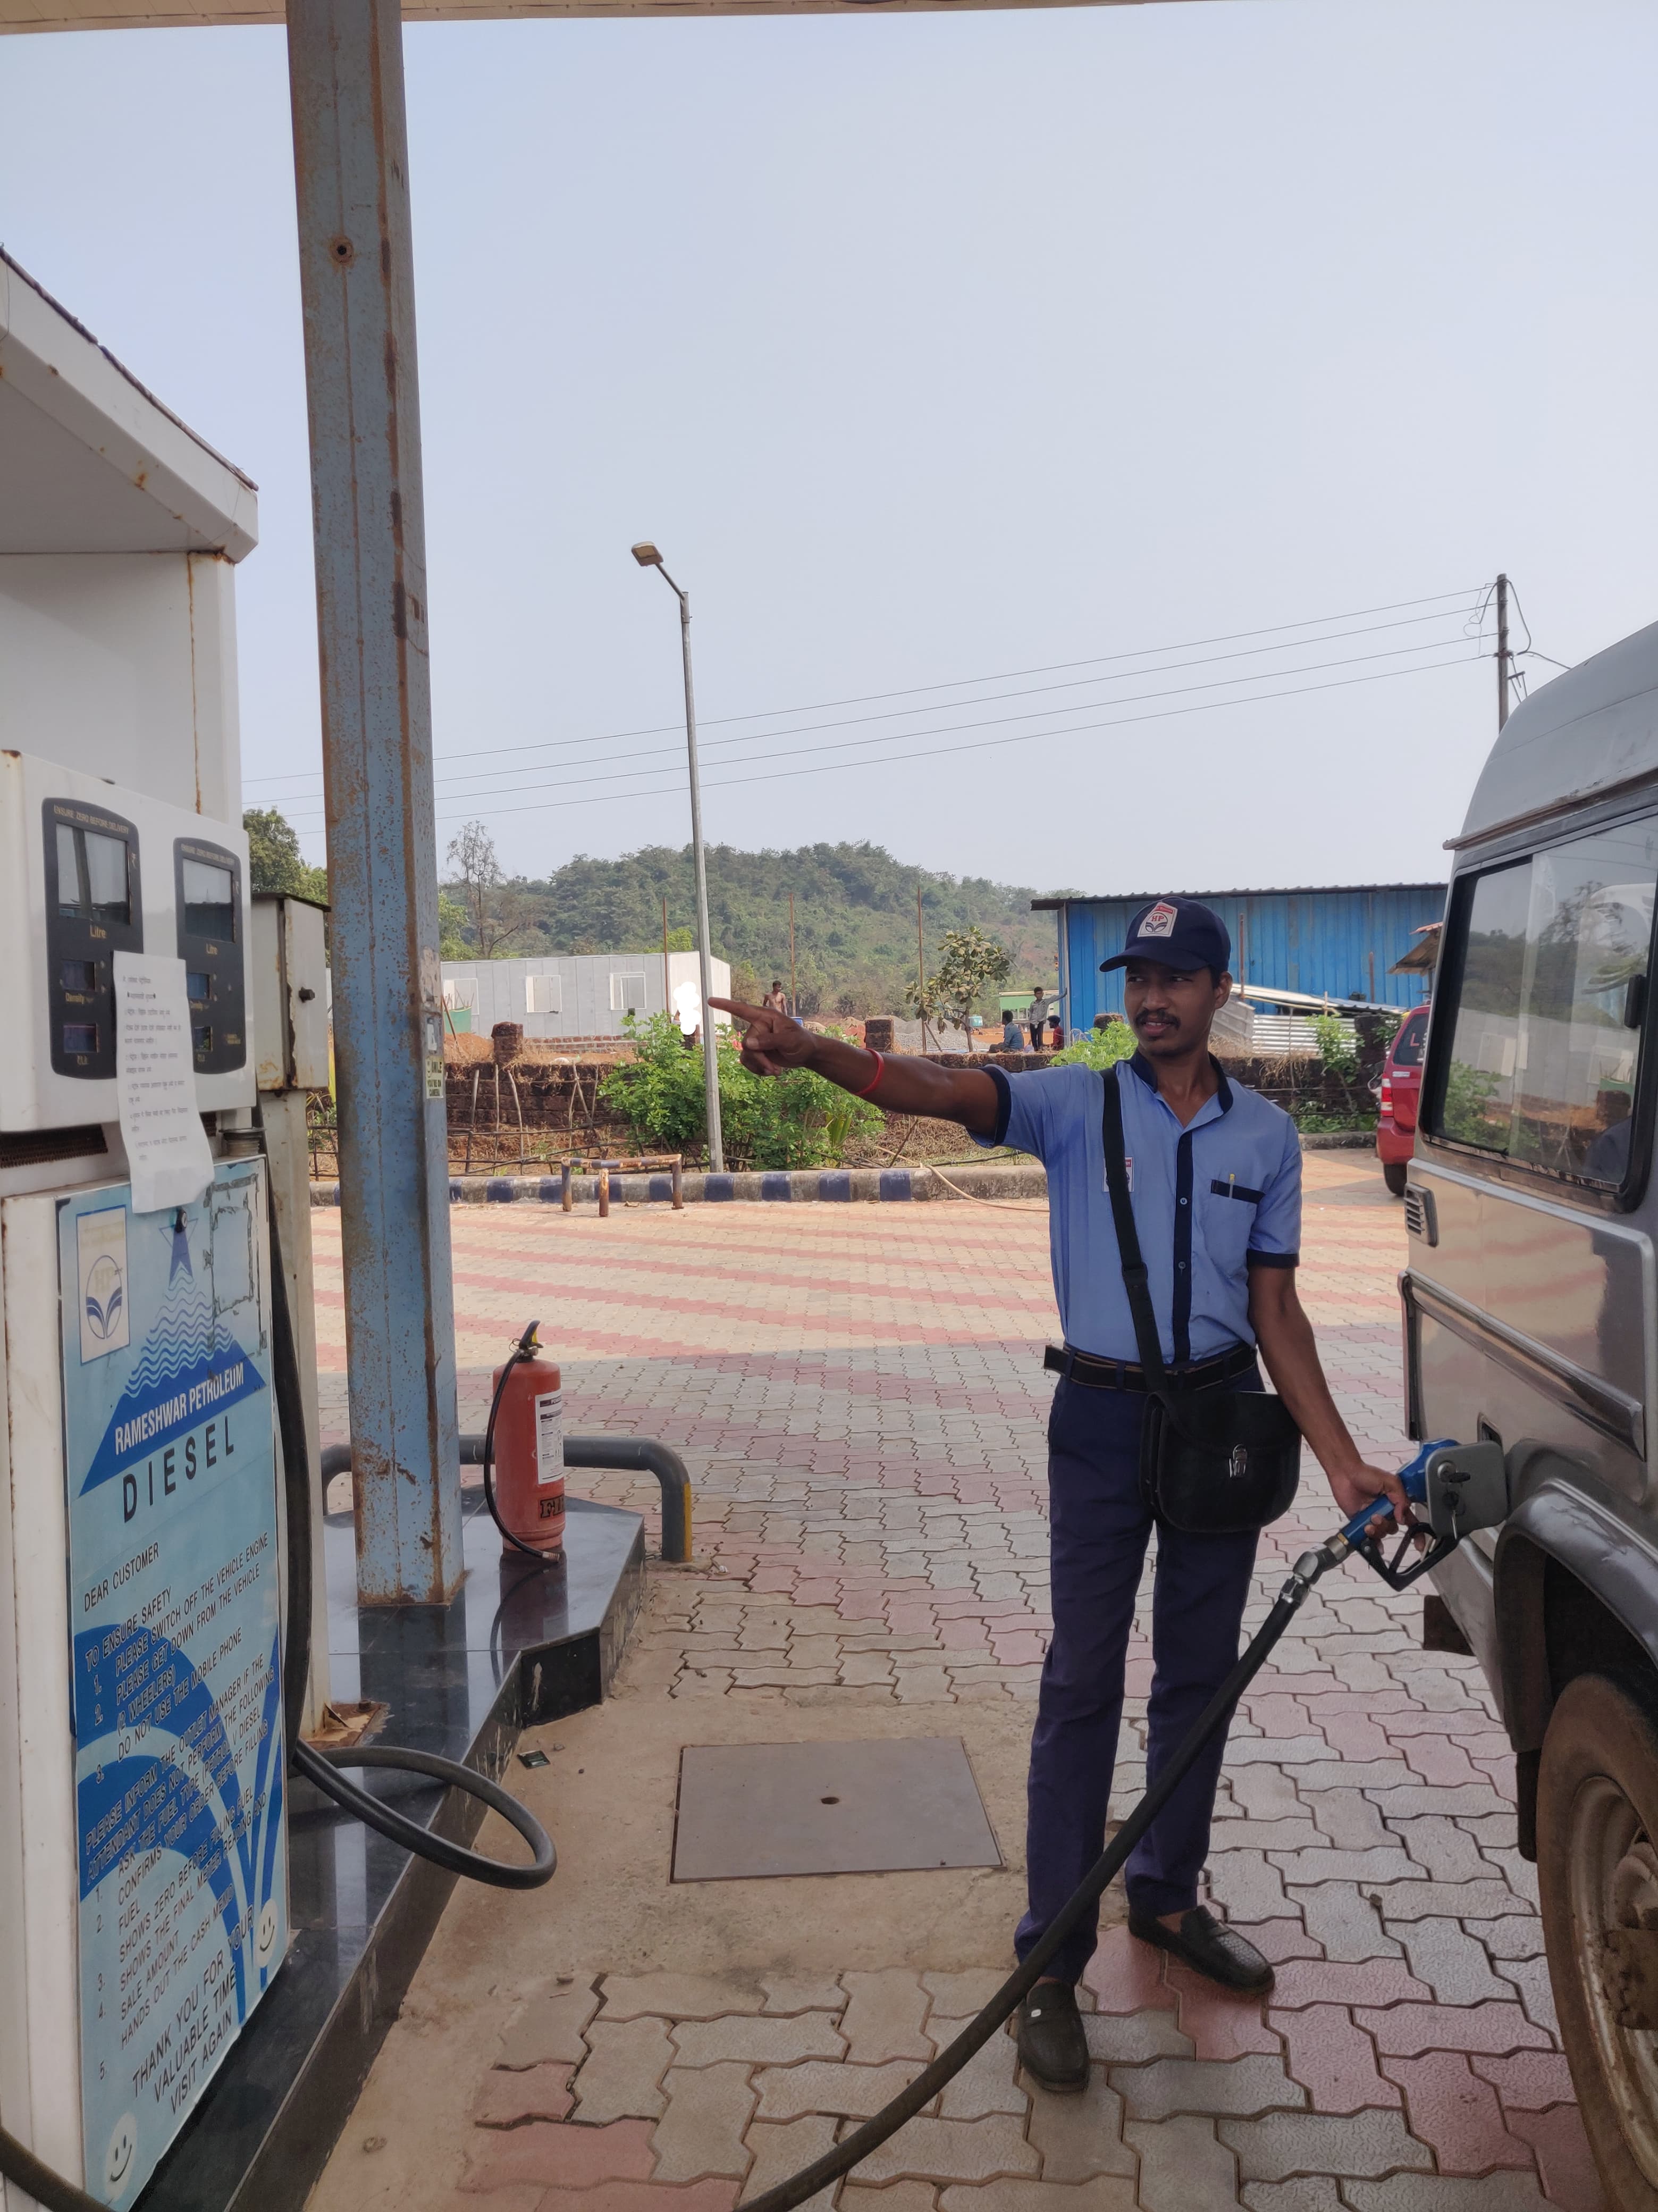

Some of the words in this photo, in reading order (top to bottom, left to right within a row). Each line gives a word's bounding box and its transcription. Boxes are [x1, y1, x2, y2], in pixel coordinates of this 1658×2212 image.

[54, 805, 74, 818] ENSURE
[76, 811, 89, 822] ZERO
[89, 816, 108, 828] BEFORE
[108, 820, 129, 834] DELIVERY
[90, 925, 106, 939] Litre
[1410, 1033, 1420, 1046] L
[115, 1393, 187, 1455] RAMESHWAR
[189, 1362, 244, 1413] PETROLEUM
[123, 1415, 234, 1523] DIESEL
[84, 1579, 109, 1612] DEAR
[113, 1542, 158, 1590] CUSTOMER
[86, 1646, 99, 1672] TO
[103, 1613, 138, 1658] ENSURE
[142, 1586, 171, 1624] SAFETY
[116, 1633, 148, 1677] PLEASE
[152, 1605, 181, 1644] SWITCH
[184, 1590, 198, 1615] OFF
[201, 1577, 214, 1600] THE
[217, 1553, 243, 1587] VEHICLE
[246, 1532, 268, 1562] ENGINE
[116, 1659, 149, 1705] PLEASE
[152, 1642, 168, 1671] GET
[171, 1620, 193, 1655] DOWN
[197, 1601, 216, 1631] FROM
[219, 1587, 231, 1610] THE
[234, 1563, 259, 1596] VEHICLE
[86, 1799, 122, 1855] PLEASE
[124, 1763, 158, 1813] INFORM
[161, 1744, 176, 1774] THE
[179, 1710, 207, 1753] OUTLET
[209, 1677, 241, 1723] MANAGER
[243, 1668, 249, 1685] IF
[252, 1653, 263, 1675] THE
[118, 1735, 130, 1763] DO
[135, 1712, 152, 1745] NOT
[154, 1694, 171, 1725] USE
[173, 1677, 189, 1706] THE
[191, 1651, 217, 1690] MOBILE
[220, 1627, 242, 1661] PHONE
[128, 1664, 176, 1722] WHEELERS)
[88, 1808, 141, 1885] ATTENDANT
[144, 1782, 166, 1821] DOES
[169, 1761, 185, 1794] NOT
[188, 1721, 223, 1771] PERFORM
[224, 1705, 237, 1728] THE
[239, 1665, 274, 1715] FOLLOWING
[119, 1842, 136, 1878] ASK
[138, 1821, 155, 1852] THE
[180, 1771, 199, 1806] TYPE
[239, 1705, 260, 1740] DIESEL
[119, 1841, 162, 1905] CONFIRMS
[164, 1813, 187, 1849] YOUR
[189, 1782, 214, 1822] ORDER
[216, 1748, 242, 1789] BEFORE
[245, 1719, 268, 1755] FILLING
[119, 1899, 140, 1936] FUEL
[120, 1912, 150, 1963] SHOWS
[154, 1881, 175, 1921] ZERO
[178, 1838, 208, 1887] BEFORE
[211, 1806, 234, 1850] FILLING
[237, 1786, 253, 1815] FUEL
[121, 1940, 152, 1992] SHOWS
[154, 1914, 170, 1945] THE
[173, 1886, 195, 1922] FINAL
[197, 1849, 222, 1891] METER
[223, 1810, 251, 1859] READING
[121, 1978, 142, 2020] SALE
[145, 1929, 179, 1988] AMOUNT
[121, 1997, 150, 2051] HANDS
[154, 1968, 170, 2003] OUT
[173, 1944, 188, 1975] THE
[190, 1916, 210, 1951] CASH
[132, 2024, 171, 2098] THANK
[176, 1983, 198, 2032] YOU
[204, 1948, 224, 1995] FOR
[227, 1904, 254, 1955] YOUR
[154, 2005, 209, 2103] VALUABLE
[213, 1962, 236, 2014] TIME
[171, 2057, 197, 2115] VISIT
[201, 2004, 232, 2069] AGAIN
